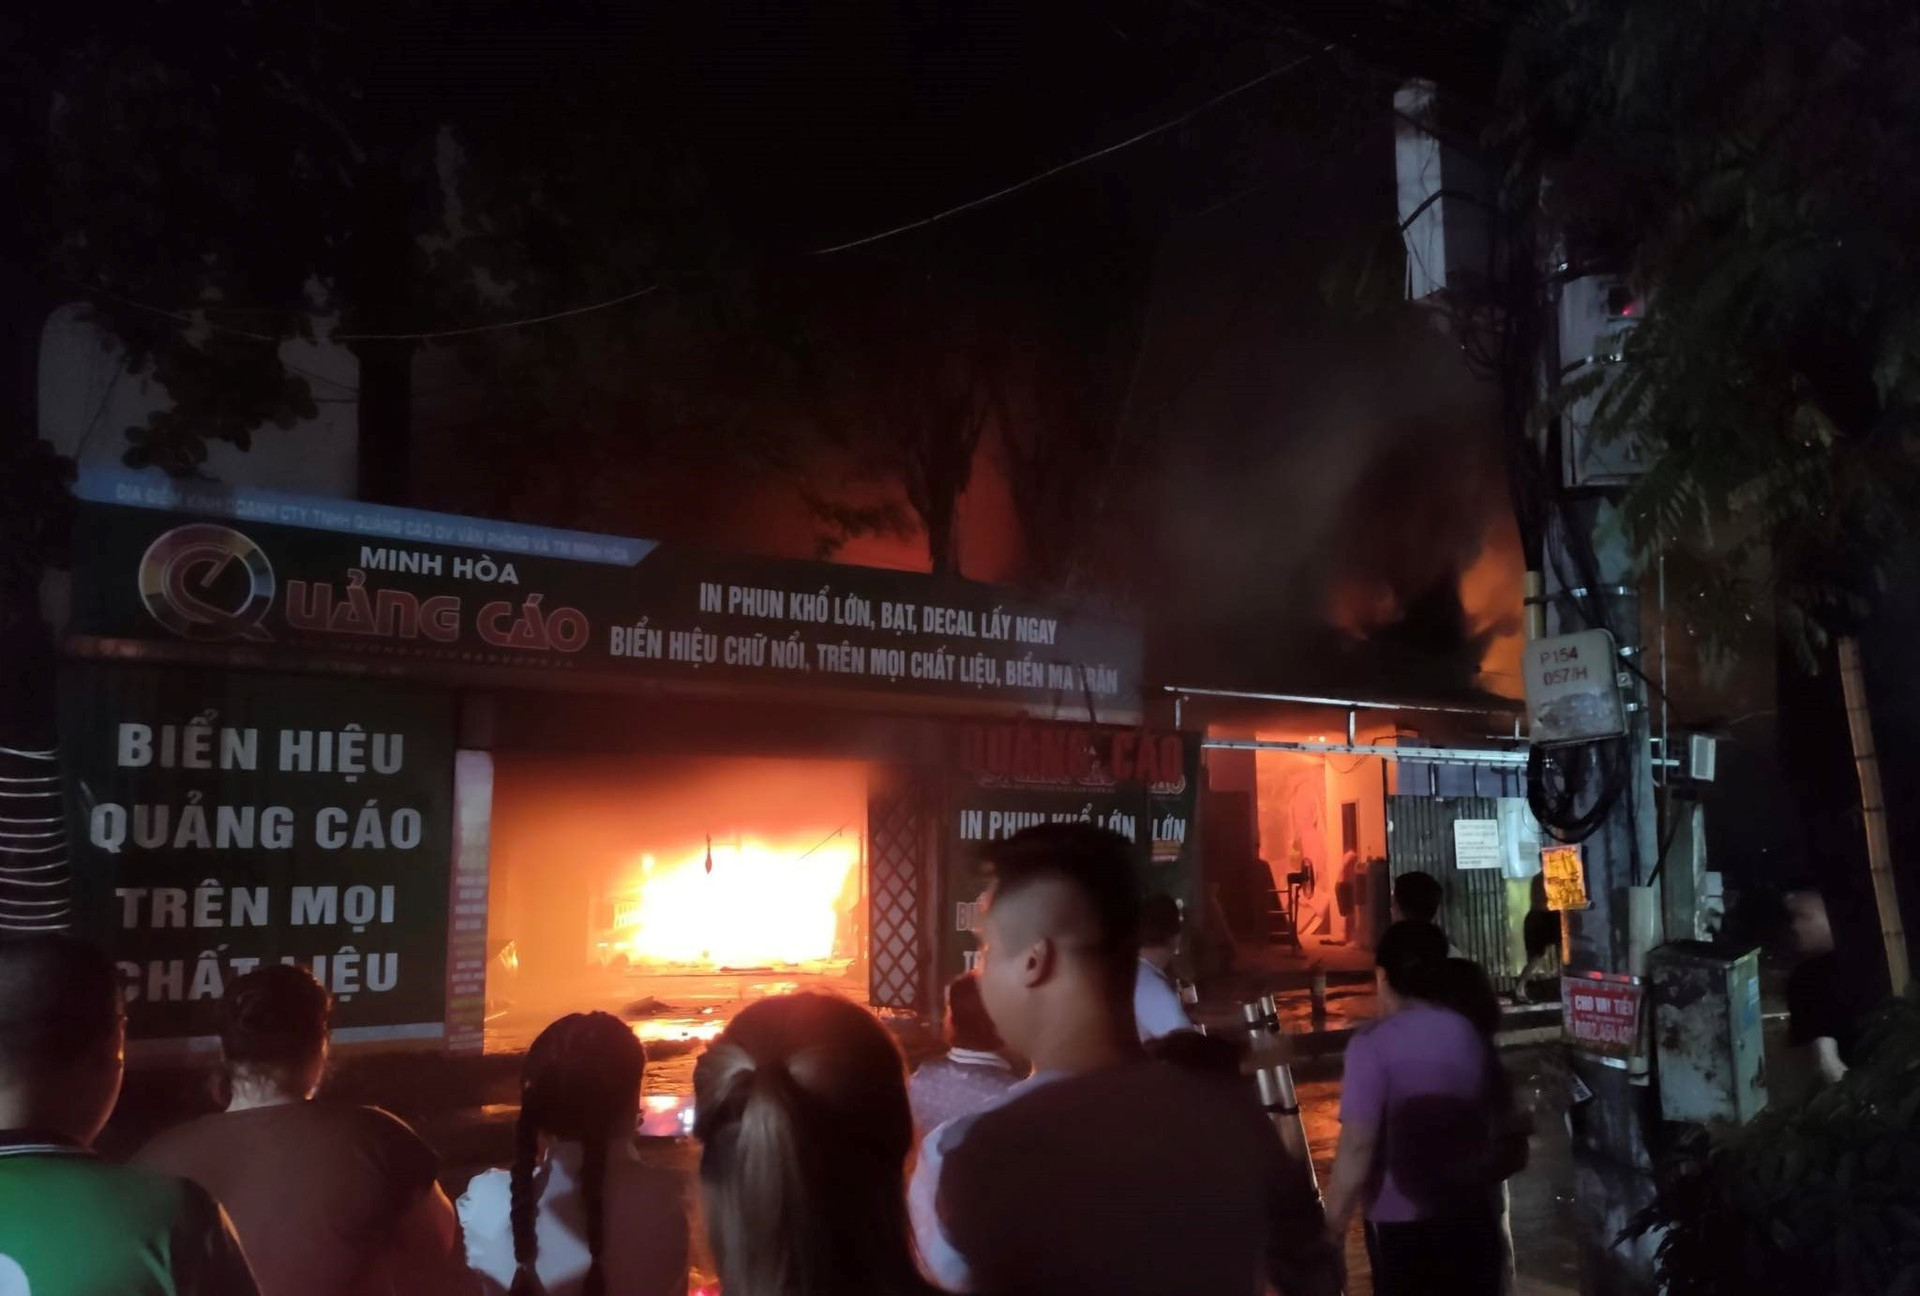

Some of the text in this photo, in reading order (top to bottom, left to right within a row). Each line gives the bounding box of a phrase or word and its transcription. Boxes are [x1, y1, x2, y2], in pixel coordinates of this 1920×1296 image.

[360, 545, 519, 585] MINH HÒA
[475, 592, 591, 653] CÁO
[700, 582, 1058, 645] IN PHUN KHỔ LỚN, BẠT, DECAL LẤY NGAY
[610, 615, 663, 660] BIỂN
[668, 625, 718, 669] HIỆU
[723, 633, 767, 667] CHỮ
[817, 639, 865, 675] TRÊN
[870, 648, 905, 682] MỌI
[910, 645, 955, 681] CHẤT
[117, 708, 404, 783] BIỂN HIỆU
[89, 789, 422, 854] QUẢNG CÁO
[960, 809, 983, 840] IN
[1151, 812, 1186, 844] LỚN
[115, 877, 395, 933] TRÊN MỌI
[280, 945, 399, 1003] IỆU
